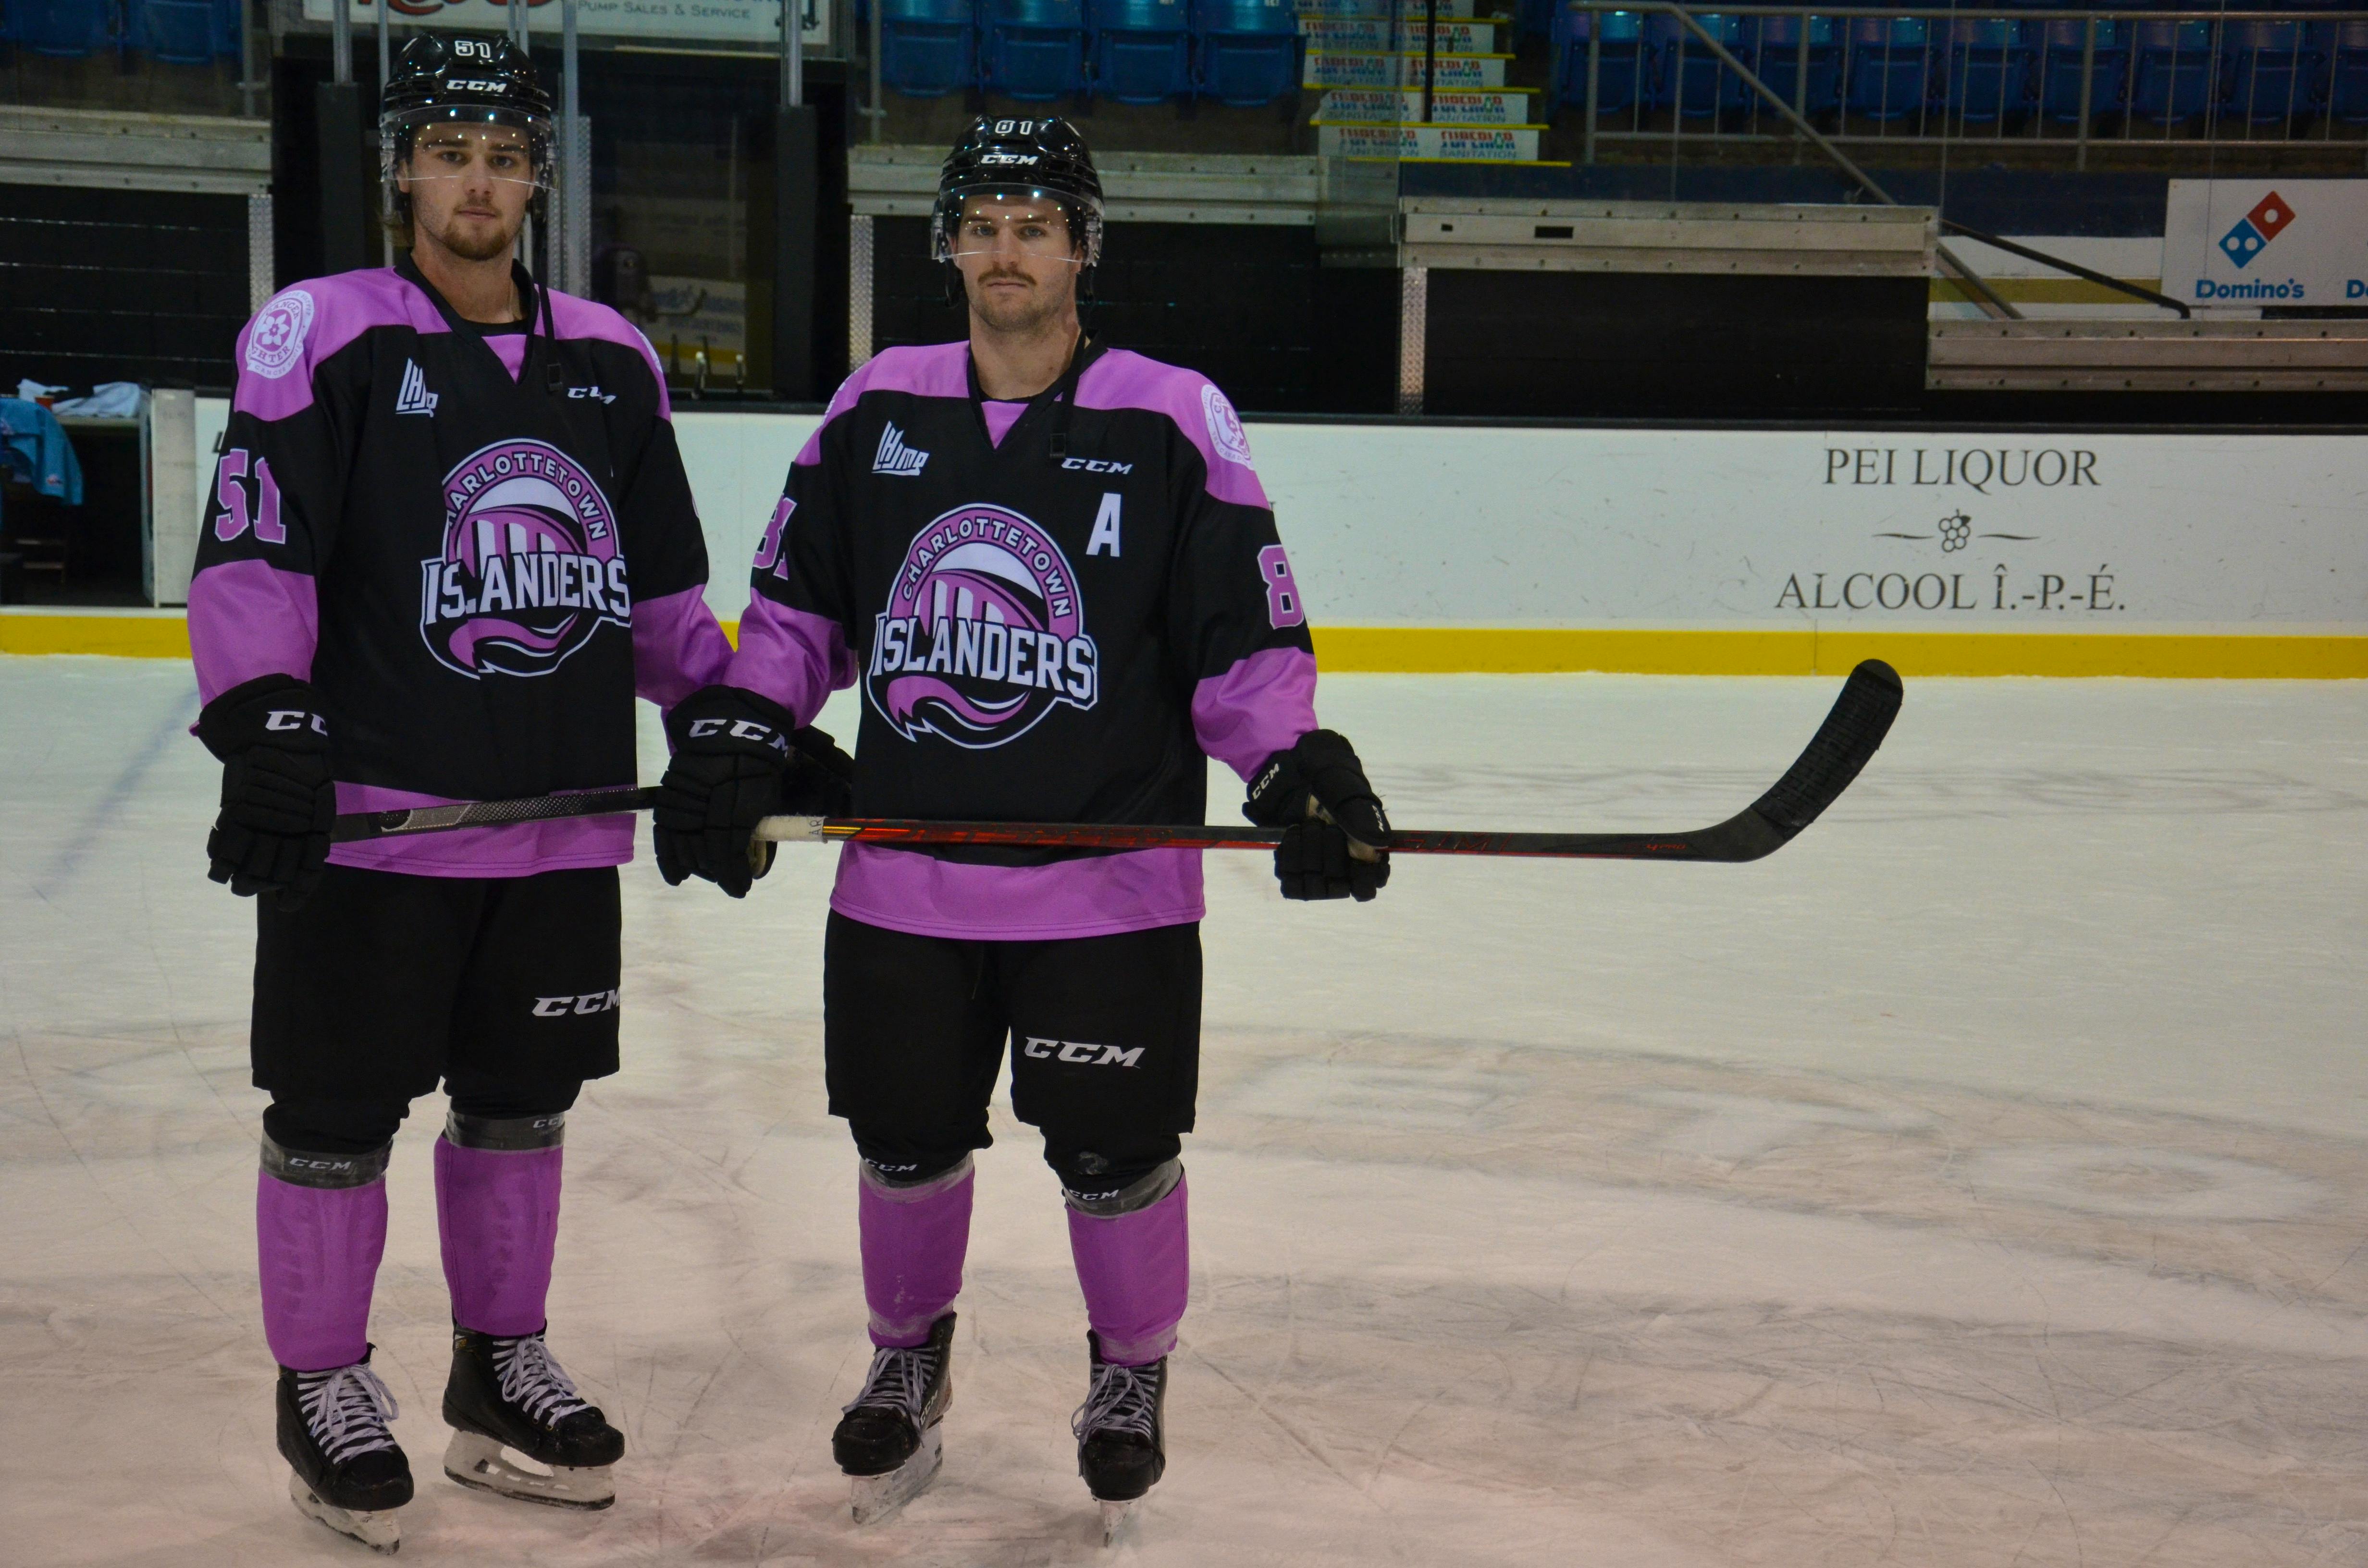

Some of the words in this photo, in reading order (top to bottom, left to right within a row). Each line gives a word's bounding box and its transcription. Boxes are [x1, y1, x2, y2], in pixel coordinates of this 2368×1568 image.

[624, 2, 668, 15] SALES
[674, 4, 686, 16] &
[691, 5, 751, 19] SERVICE
[455, 40, 490, 58] 51
[446, 80, 507, 93] CCM
[981, 155, 1038, 165] CCM
[2196, 279, 2304, 298] Domino's
[1061, 457, 1133, 475] CCM
[1823, 448, 1898, 485] PEI
[1912, 449, 2101, 495] LIQUOR
[215, 448, 286, 544] 51
[448, 452, 608, 540] HARLOTTETOWN
[1086, 492, 1122, 557] A
[903, 516, 1072, 618] CHARLOTTETOWN
[1775, 572, 1977, 610] ALCOOL
[1992, 564, 2125, 611] Î.-P.-É.
[871, 615, 1096, 699] ISLANDERS
[1252, 763, 1280, 800] CCM
[1024, 1036, 1146, 1068] CCM
[289, 1157, 352, 1171] CCM
[863, 1158, 918, 1173] CCM
[1069, 1189, 1119, 1200] CCM
[920, 1389, 938, 1425] CCM
